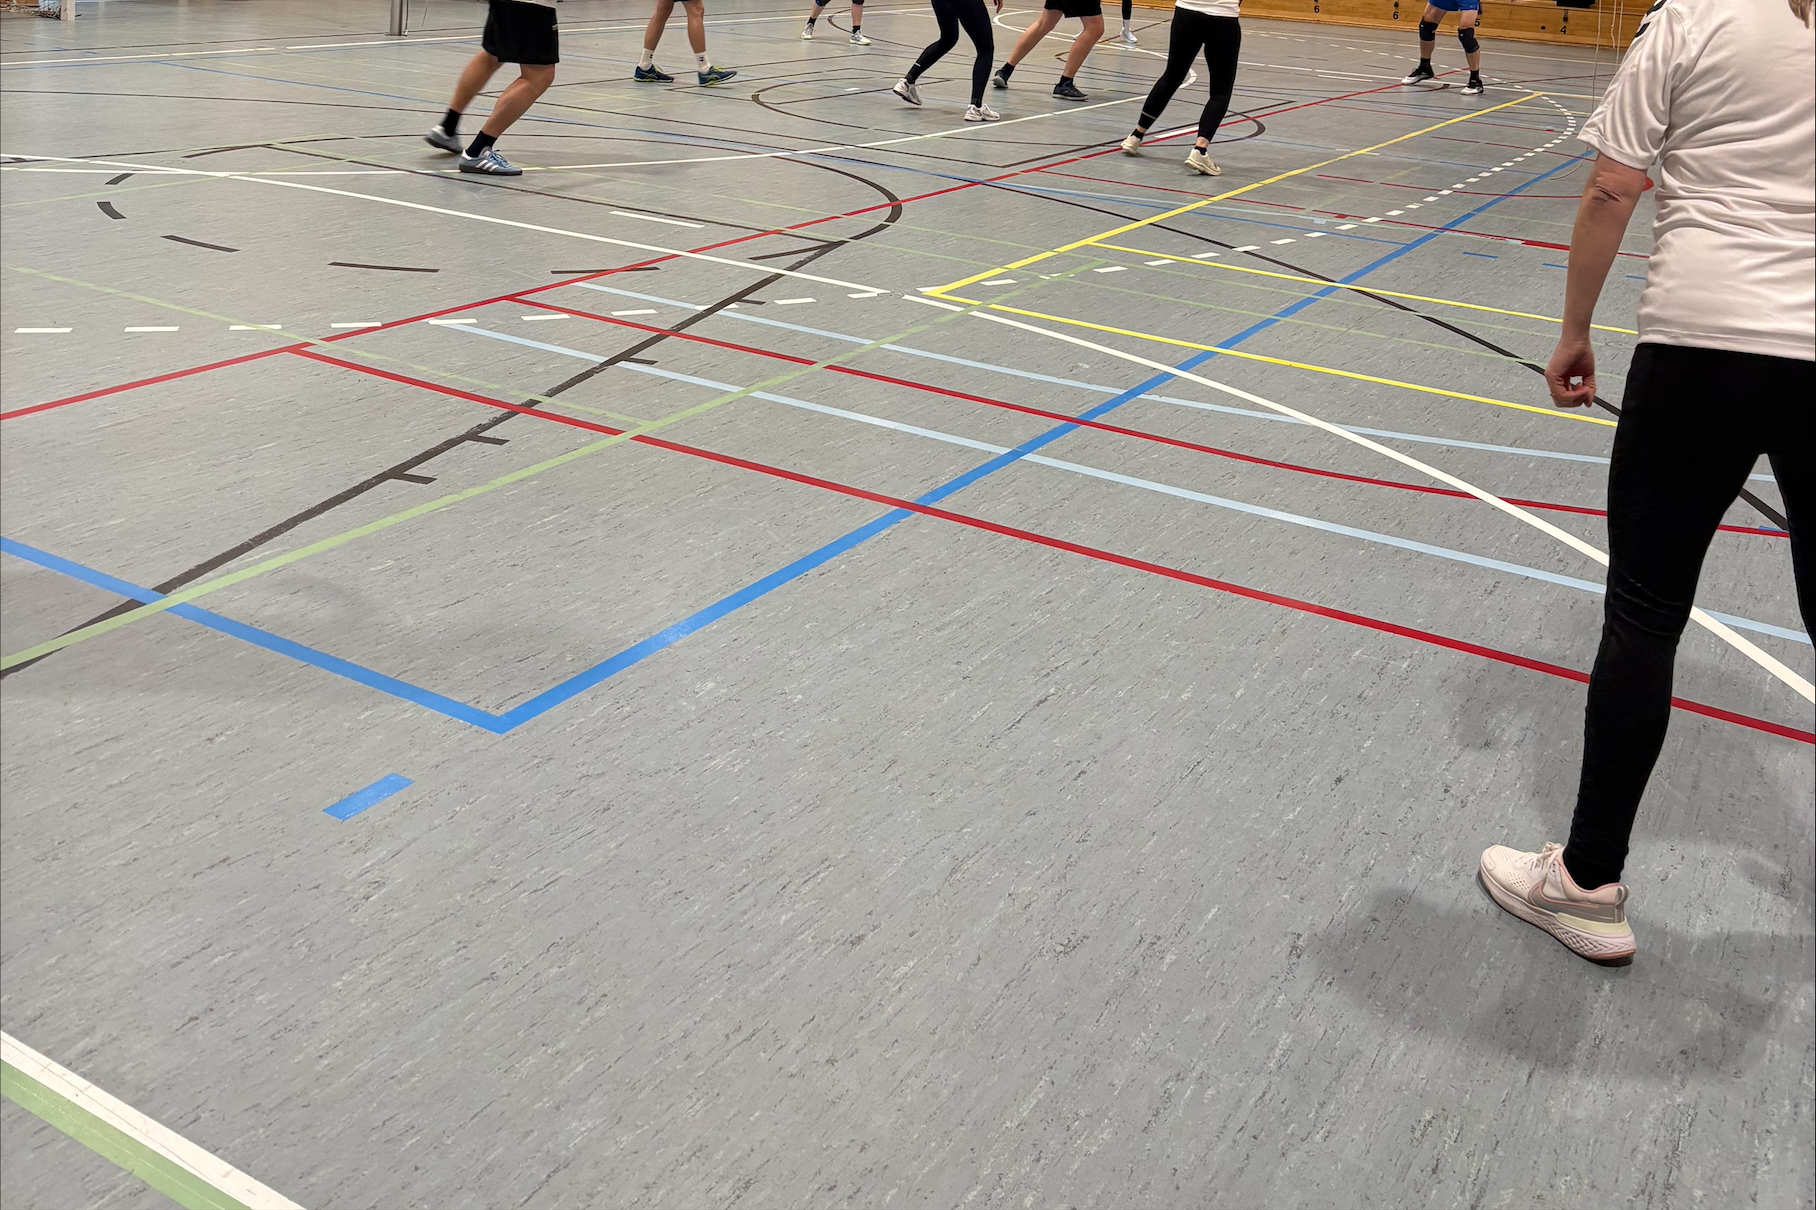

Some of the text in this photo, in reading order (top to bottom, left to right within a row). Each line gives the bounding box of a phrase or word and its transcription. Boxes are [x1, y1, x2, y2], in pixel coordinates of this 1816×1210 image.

[1314, 5, 1320, 13] 6
[1393, 11, 1399, 19] 6
[1560, 25, 1567, 34] 4
